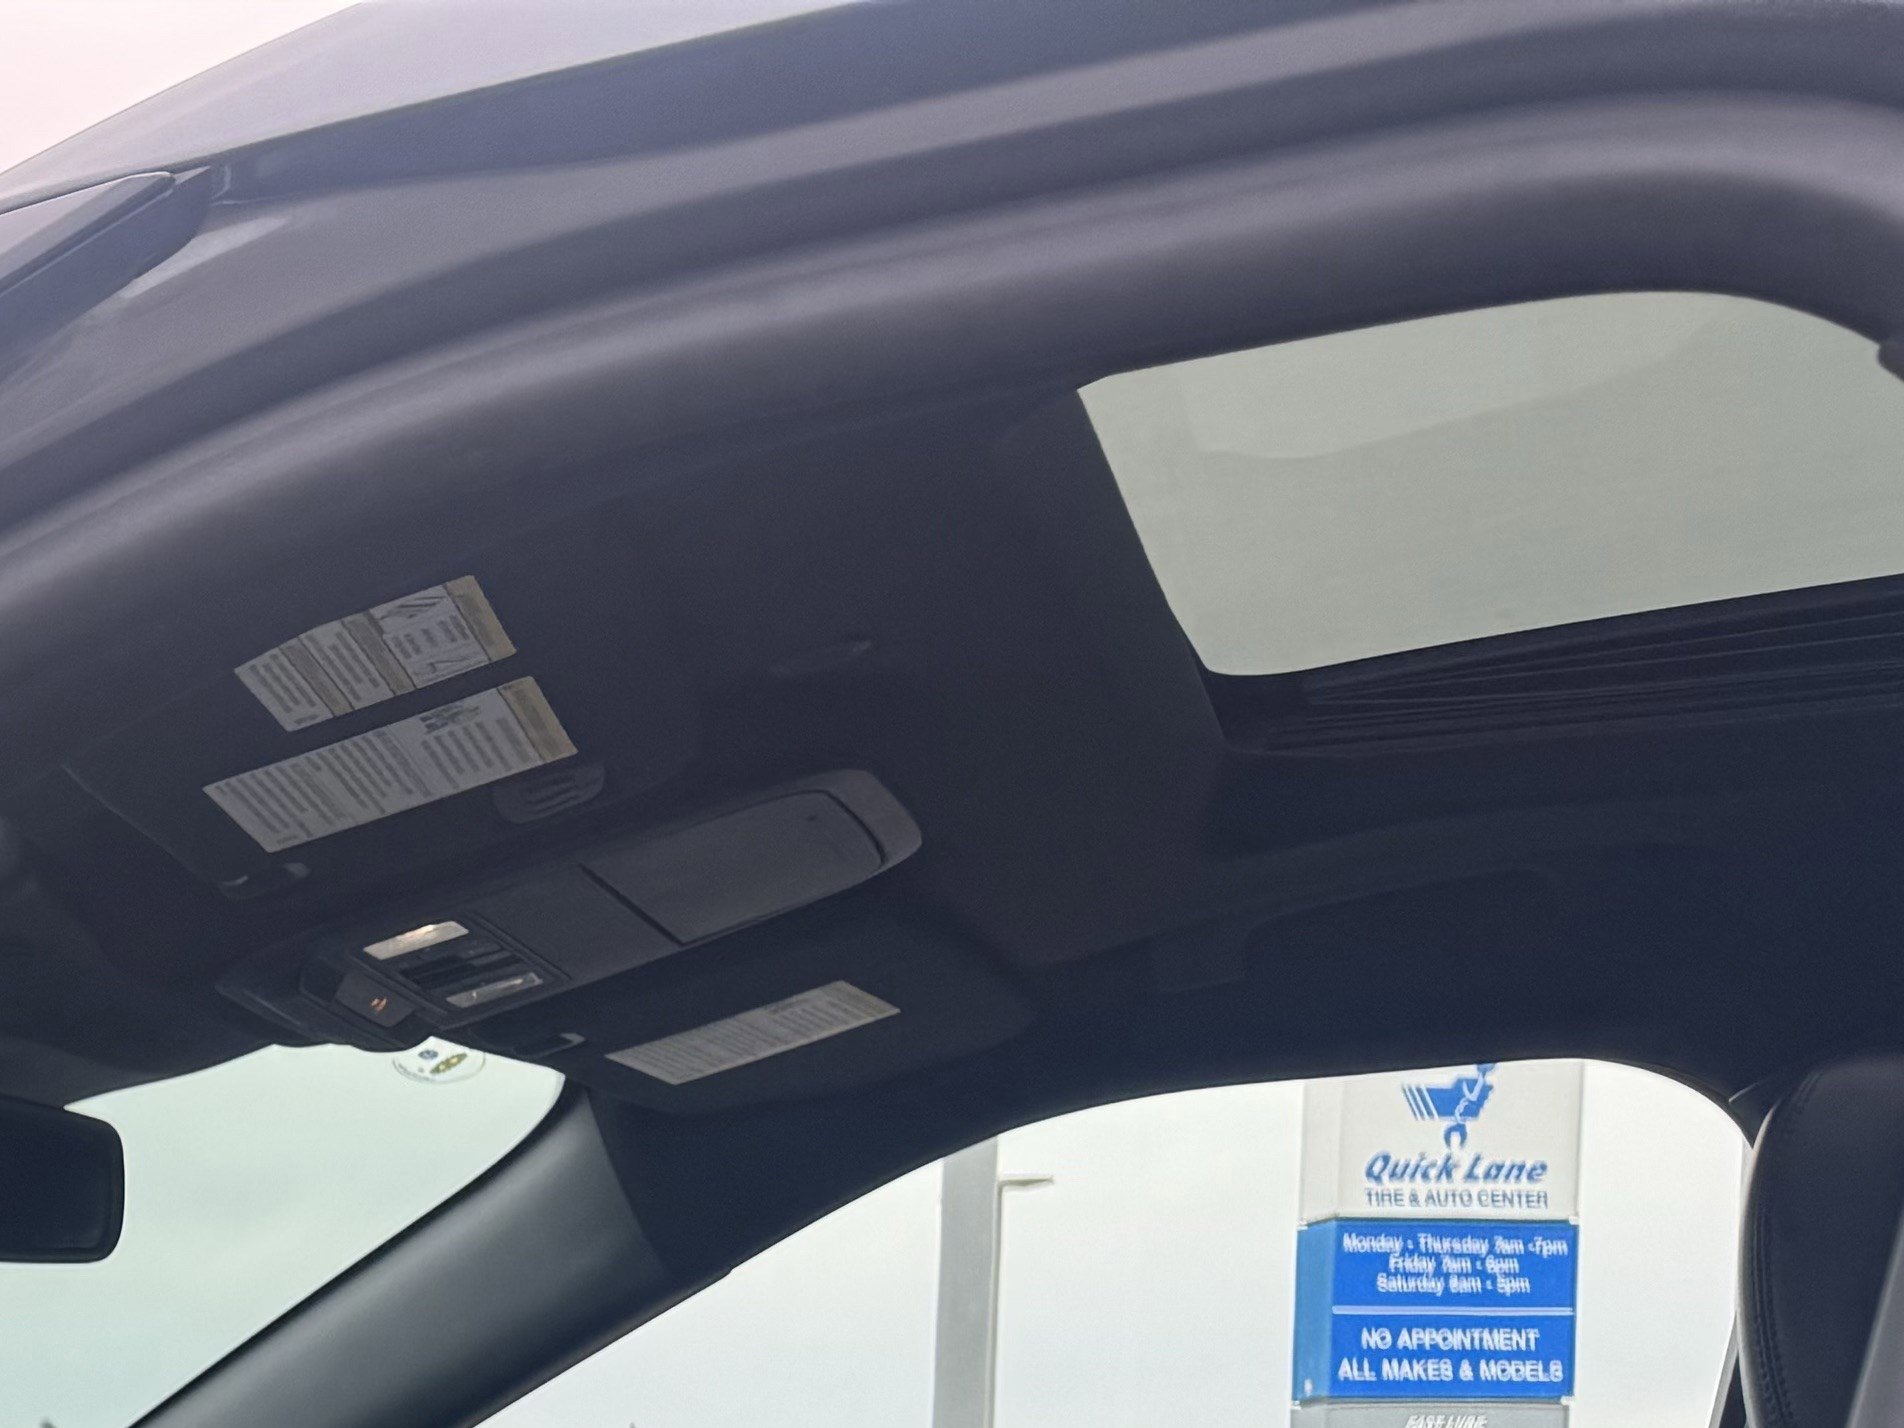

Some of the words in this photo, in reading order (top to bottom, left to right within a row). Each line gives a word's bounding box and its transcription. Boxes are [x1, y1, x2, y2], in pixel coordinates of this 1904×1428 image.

[1365, 1150, 1459, 1184] Quick
[1464, 1151, 1548, 1184] Lane
[1365, 1187, 1405, 1207] TIRE
[1410, 1188, 1421, 1207] &
[1425, 1188, 1472, 1208] AUTO
[1477, 1189, 1548, 1209] CENTER
[1343, 1232, 1403, 1256] Monday
[1417, 1232, 1490, 1257] Thursday
[1389, 1254, 1436, 1277] Friday
[1377, 1273, 1444, 1296] Saturday
[1361, 1327, 1391, 1350] NO
[1396, 1327, 1540, 1352] APPOINTMENT
[1338, 1357, 1377, 1381] ALL
[1382, 1358, 1453, 1382] MAKES
[1459, 1359, 1474, 1381] &
[1480, 1359, 1563, 1382] MODELS
